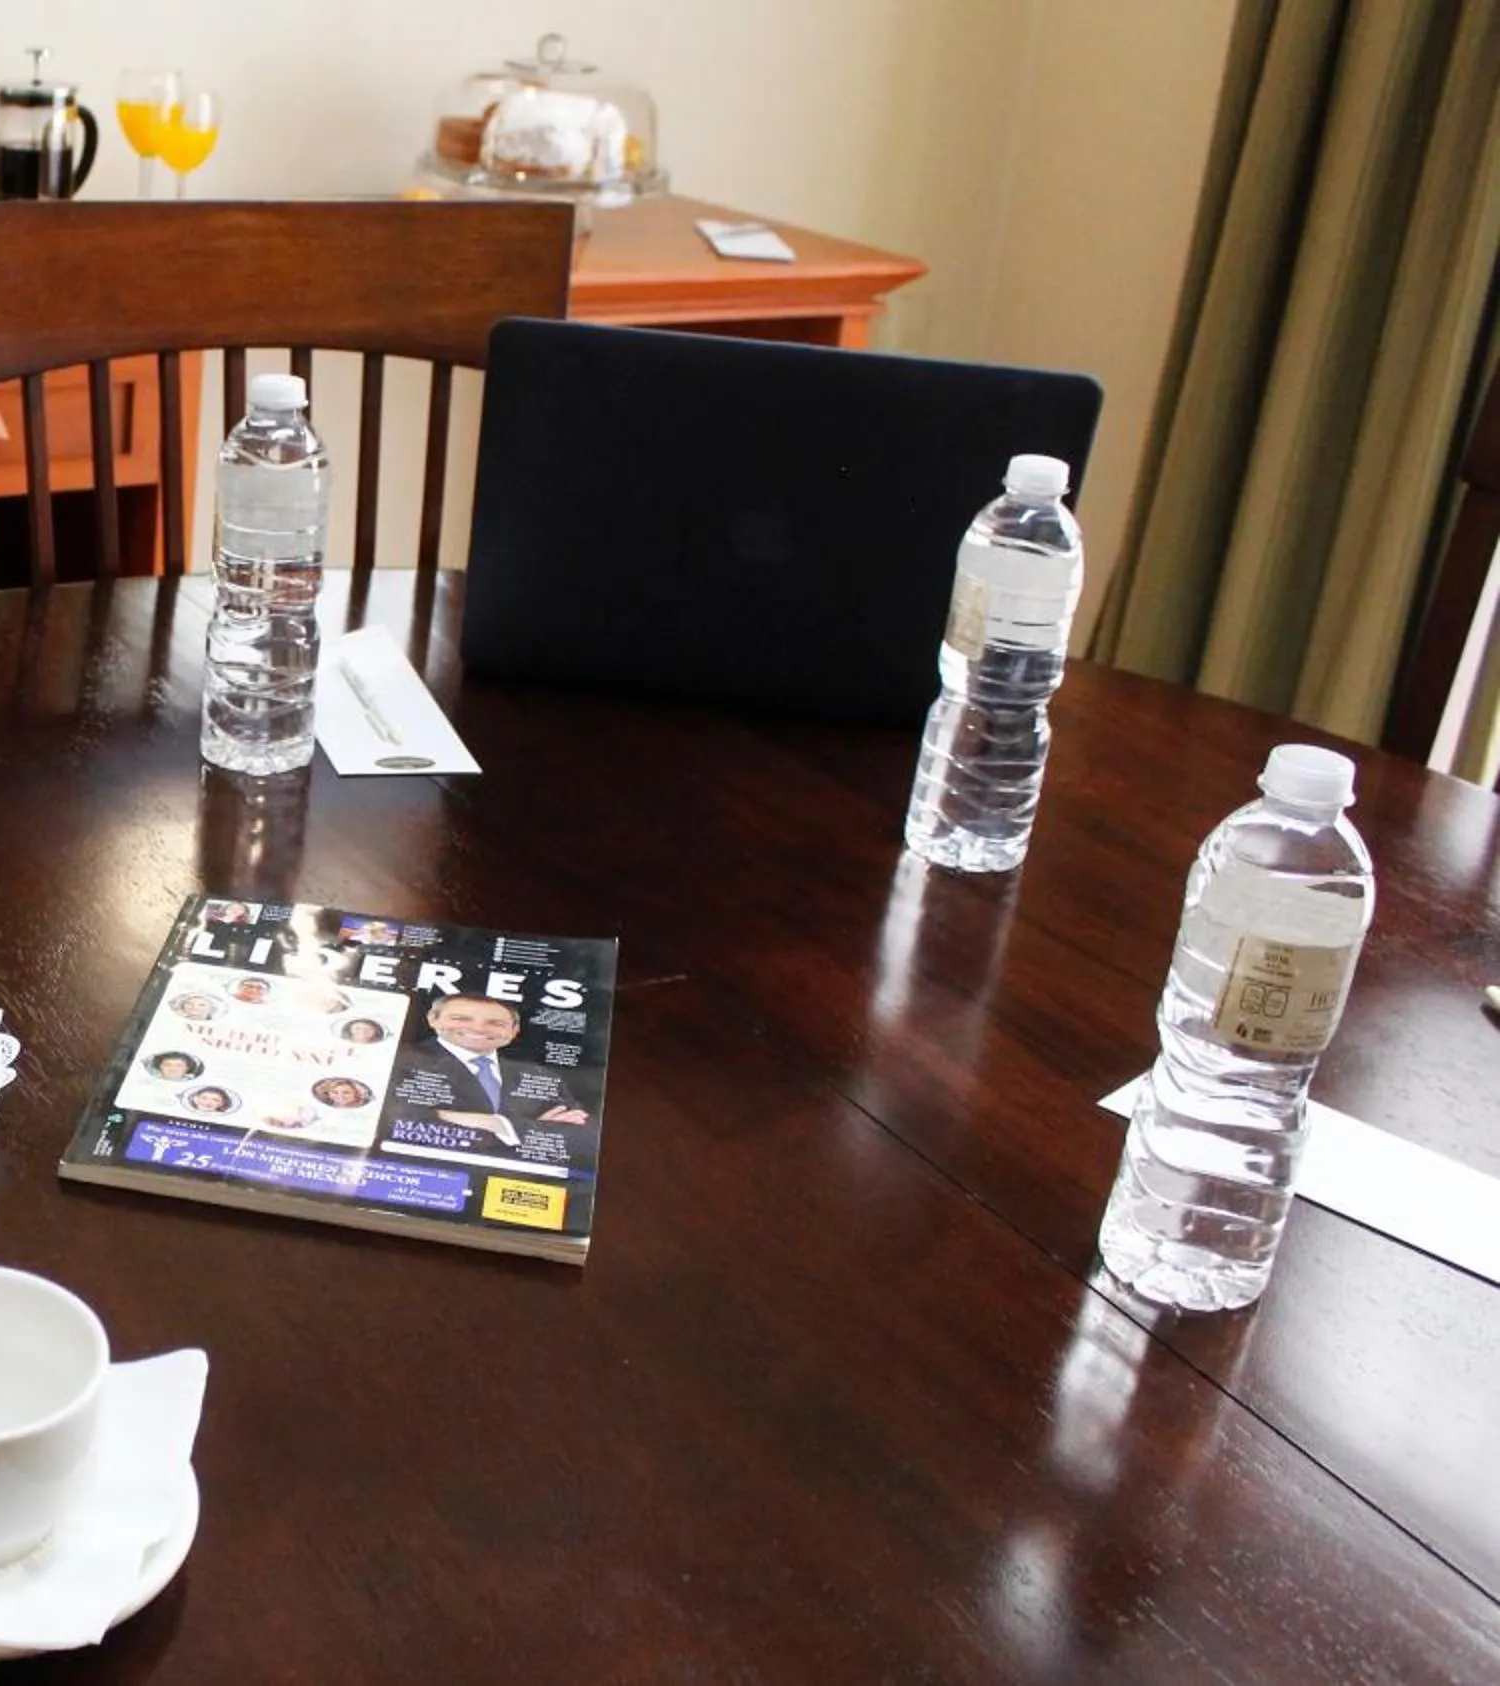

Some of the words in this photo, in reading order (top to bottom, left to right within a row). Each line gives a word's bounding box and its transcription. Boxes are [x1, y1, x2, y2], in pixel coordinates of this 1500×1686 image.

[392, 1129, 457, 1147] ROMO
[393, 1119, 483, 1141] MANUEL
[173, 1152, 214, 1168] 25
